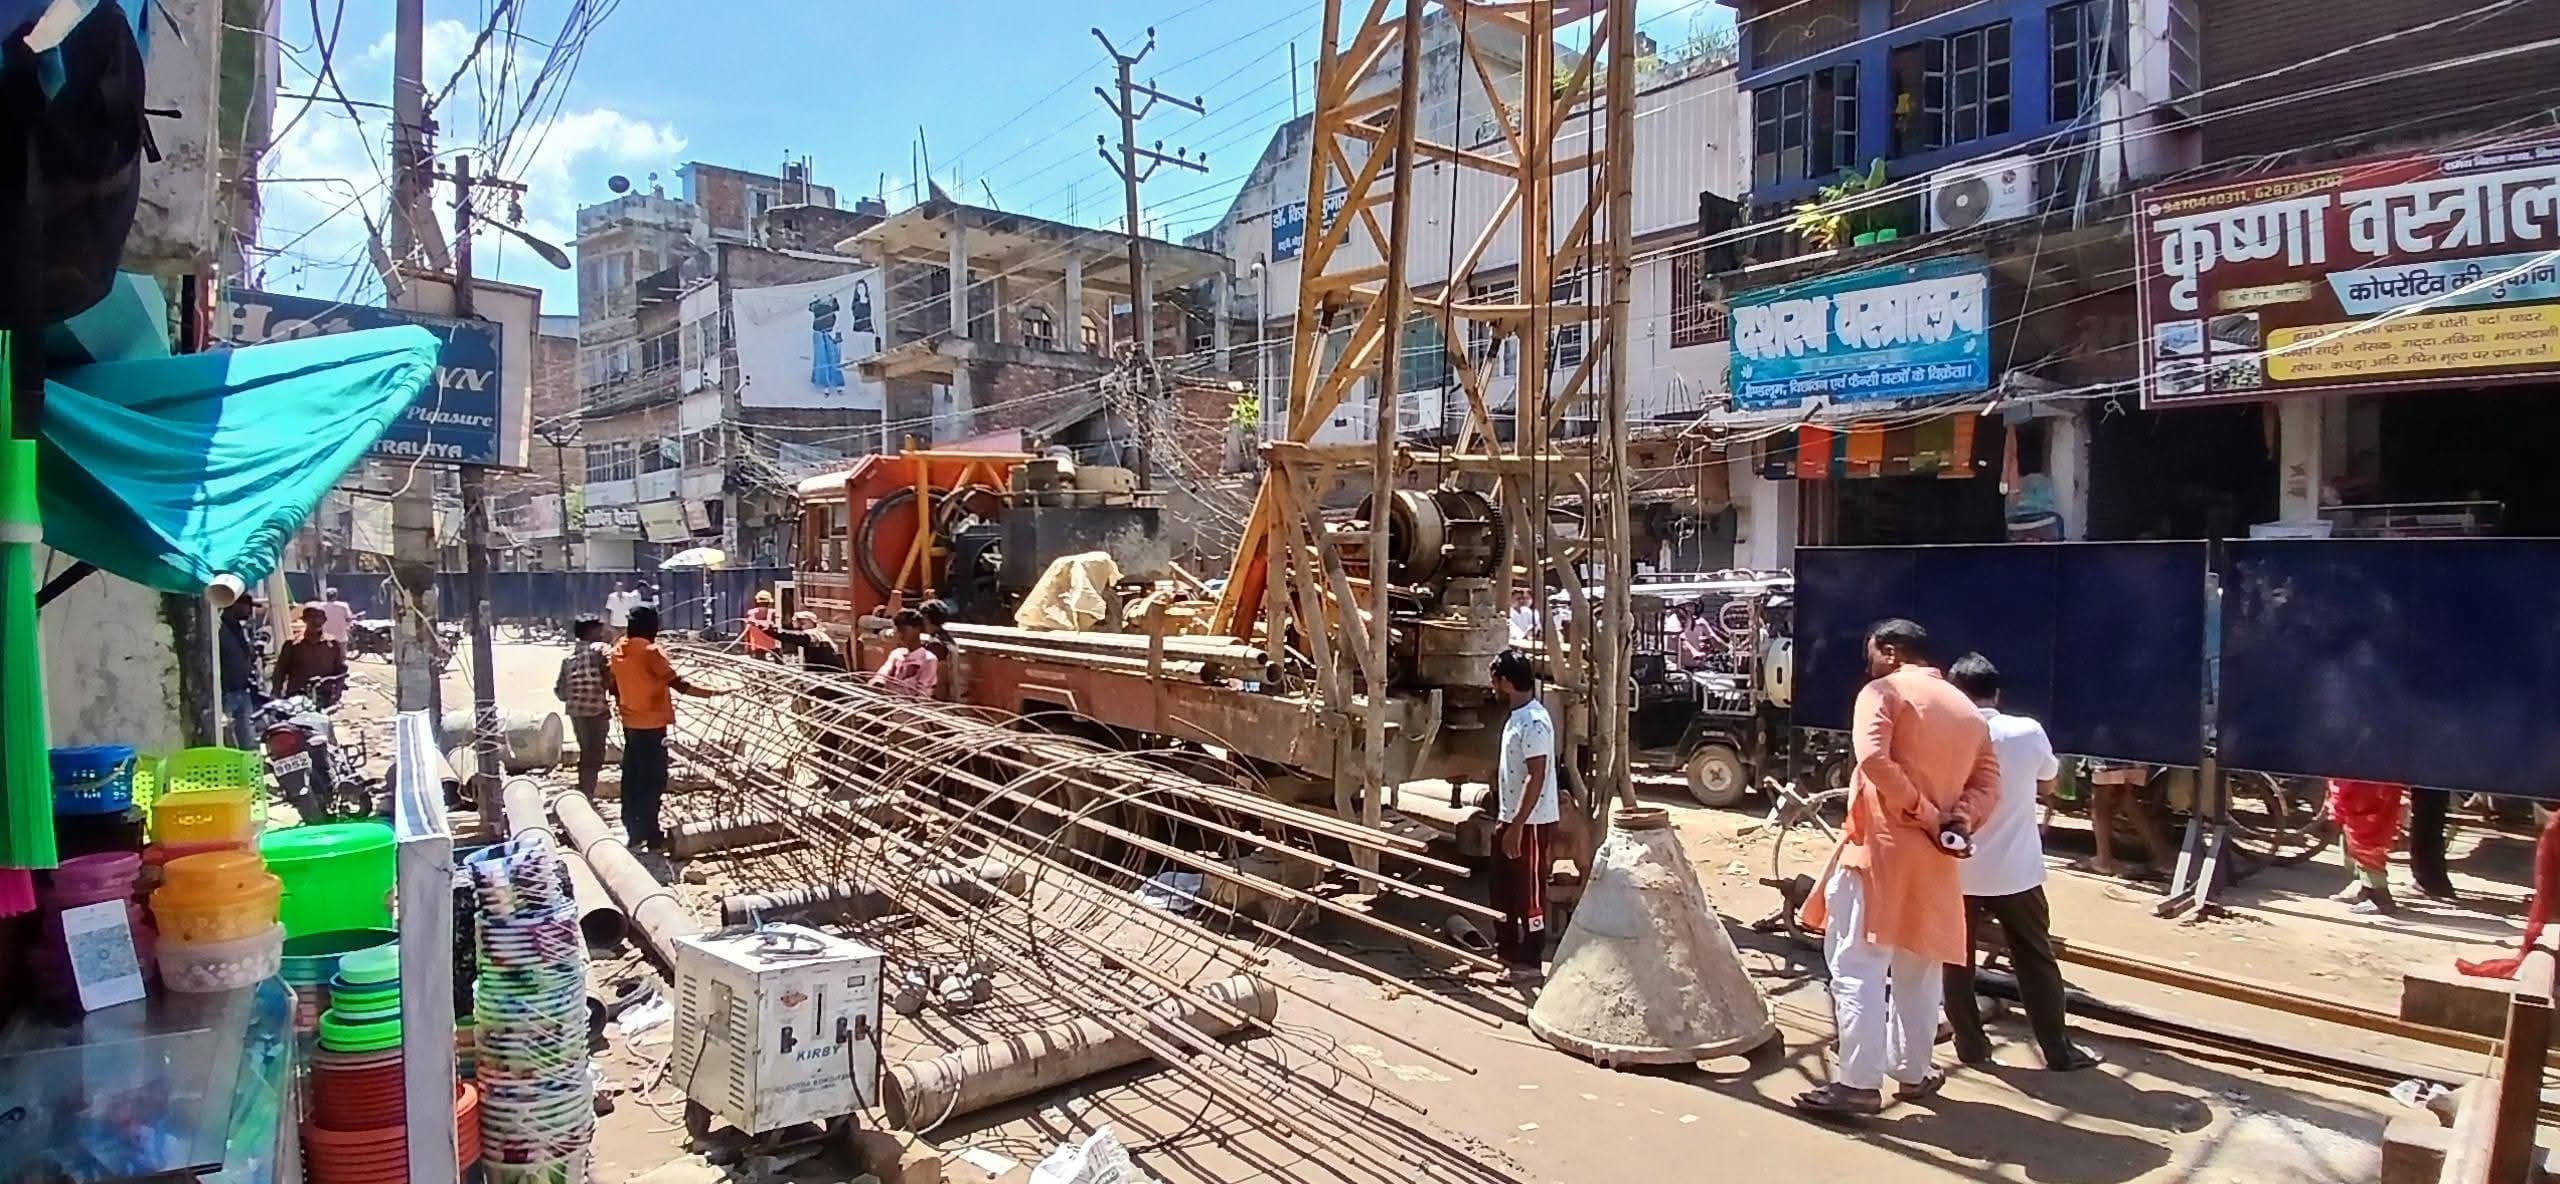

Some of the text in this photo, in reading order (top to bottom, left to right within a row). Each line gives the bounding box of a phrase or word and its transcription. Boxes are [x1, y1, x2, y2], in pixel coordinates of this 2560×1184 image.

[2153, 195, 2331, 312] कृष्णा
[2349, 268, 2446, 301] कोपरेटिव
[2451, 263, 2483, 291] की
[1833, 273, 1988, 349] वस्त्रालय
[407, 405, 493, 427] Pleasure
[796, 1044, 842, 1062] KIRBY
